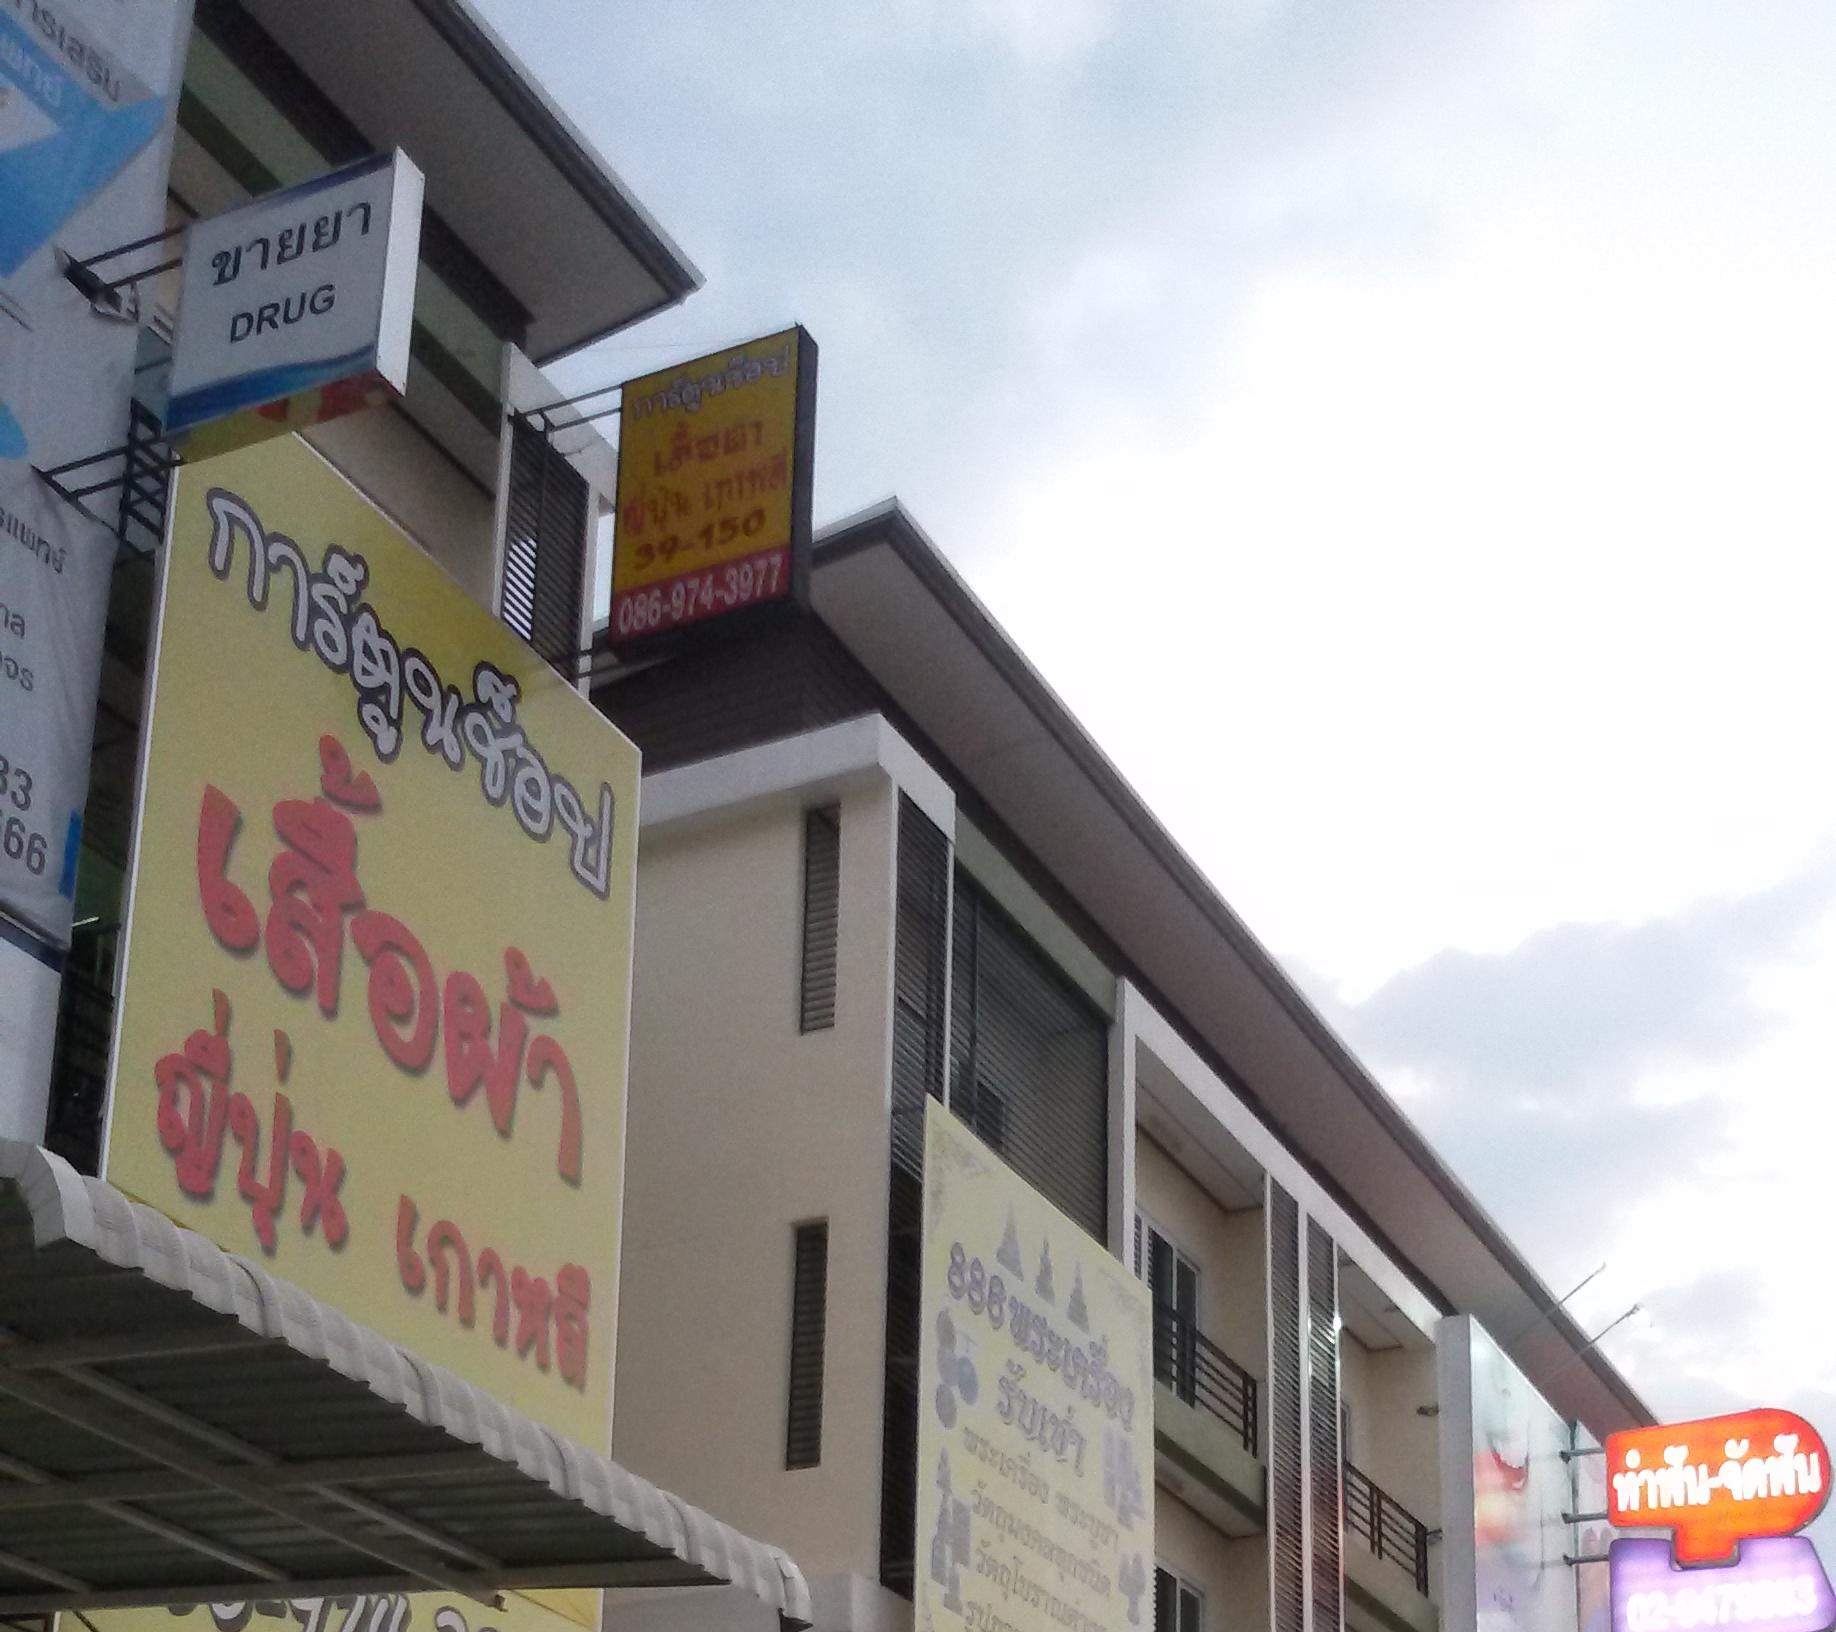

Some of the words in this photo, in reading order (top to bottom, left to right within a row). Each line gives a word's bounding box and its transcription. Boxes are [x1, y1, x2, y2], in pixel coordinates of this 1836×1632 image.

[211, 202, 372, 286] ขายยา
[231, 284, 336, 344] DRUG
[633, 506, 767, 572] 39-150
[618, 553, 785, 636] 086-974-3977
[196, 733, 584, 1187] เสื้อผ้า
[154, 986, 349, 1257] ญี่ปุ่น
[396, 1193, 592, 1395] เกาหลี
[947, 1241, 1007, 1330] 888
[1612, 1433, 1822, 1512] ทำฟัน-จัดฟัน
